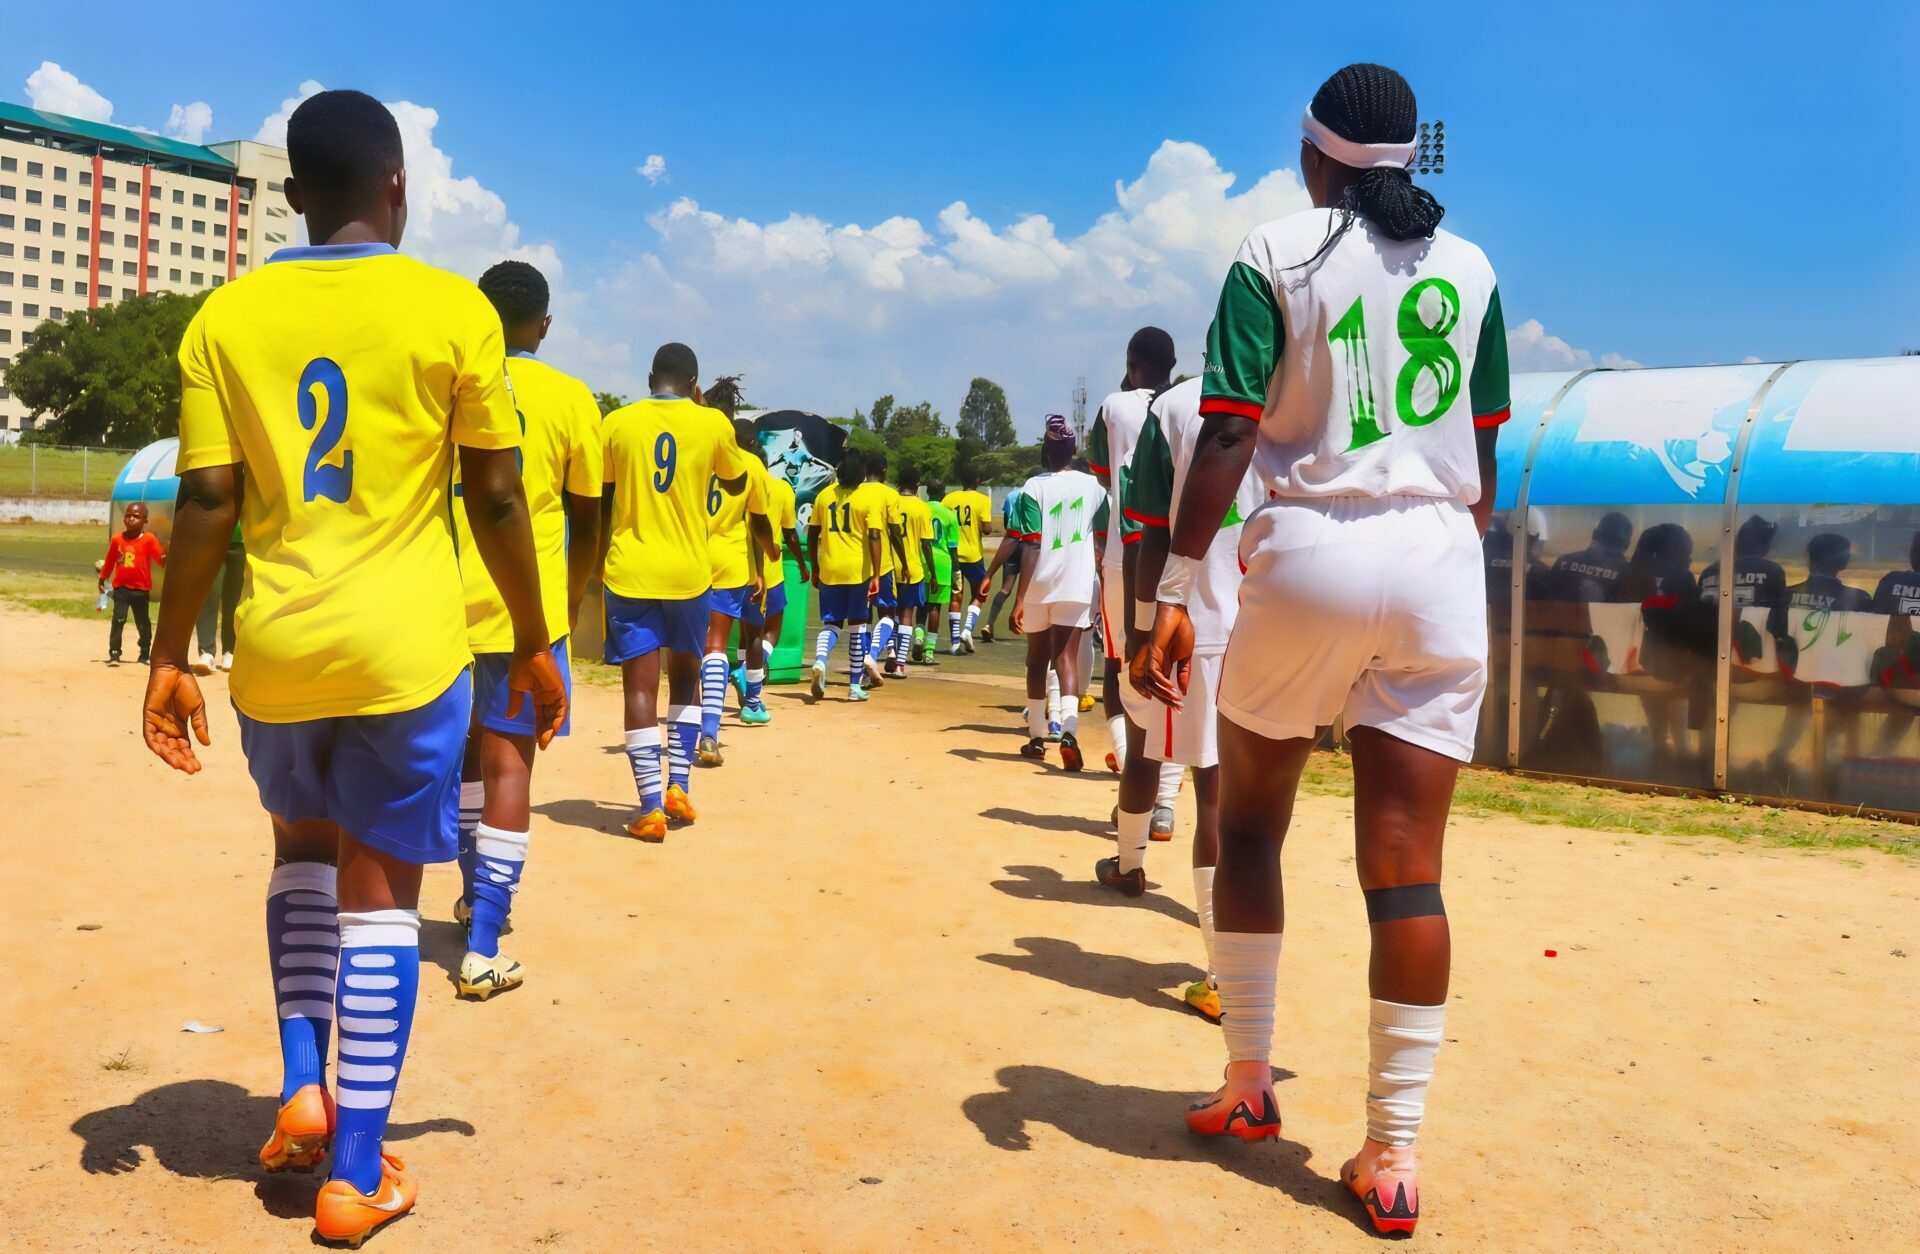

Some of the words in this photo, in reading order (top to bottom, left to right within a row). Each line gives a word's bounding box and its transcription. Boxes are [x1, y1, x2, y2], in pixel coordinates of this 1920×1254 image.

[1326, 277, 1462, 455] 18
[297, 356, 353, 503] 2
[653, 431, 677, 494] 9
[706, 474, 723, 517] 6
[828, 501, 852, 534] 11
[954, 504, 971, 527] 12
[1049, 496, 1084, 550] 11
[1570, 562, 1619, 580] DOCTOR
